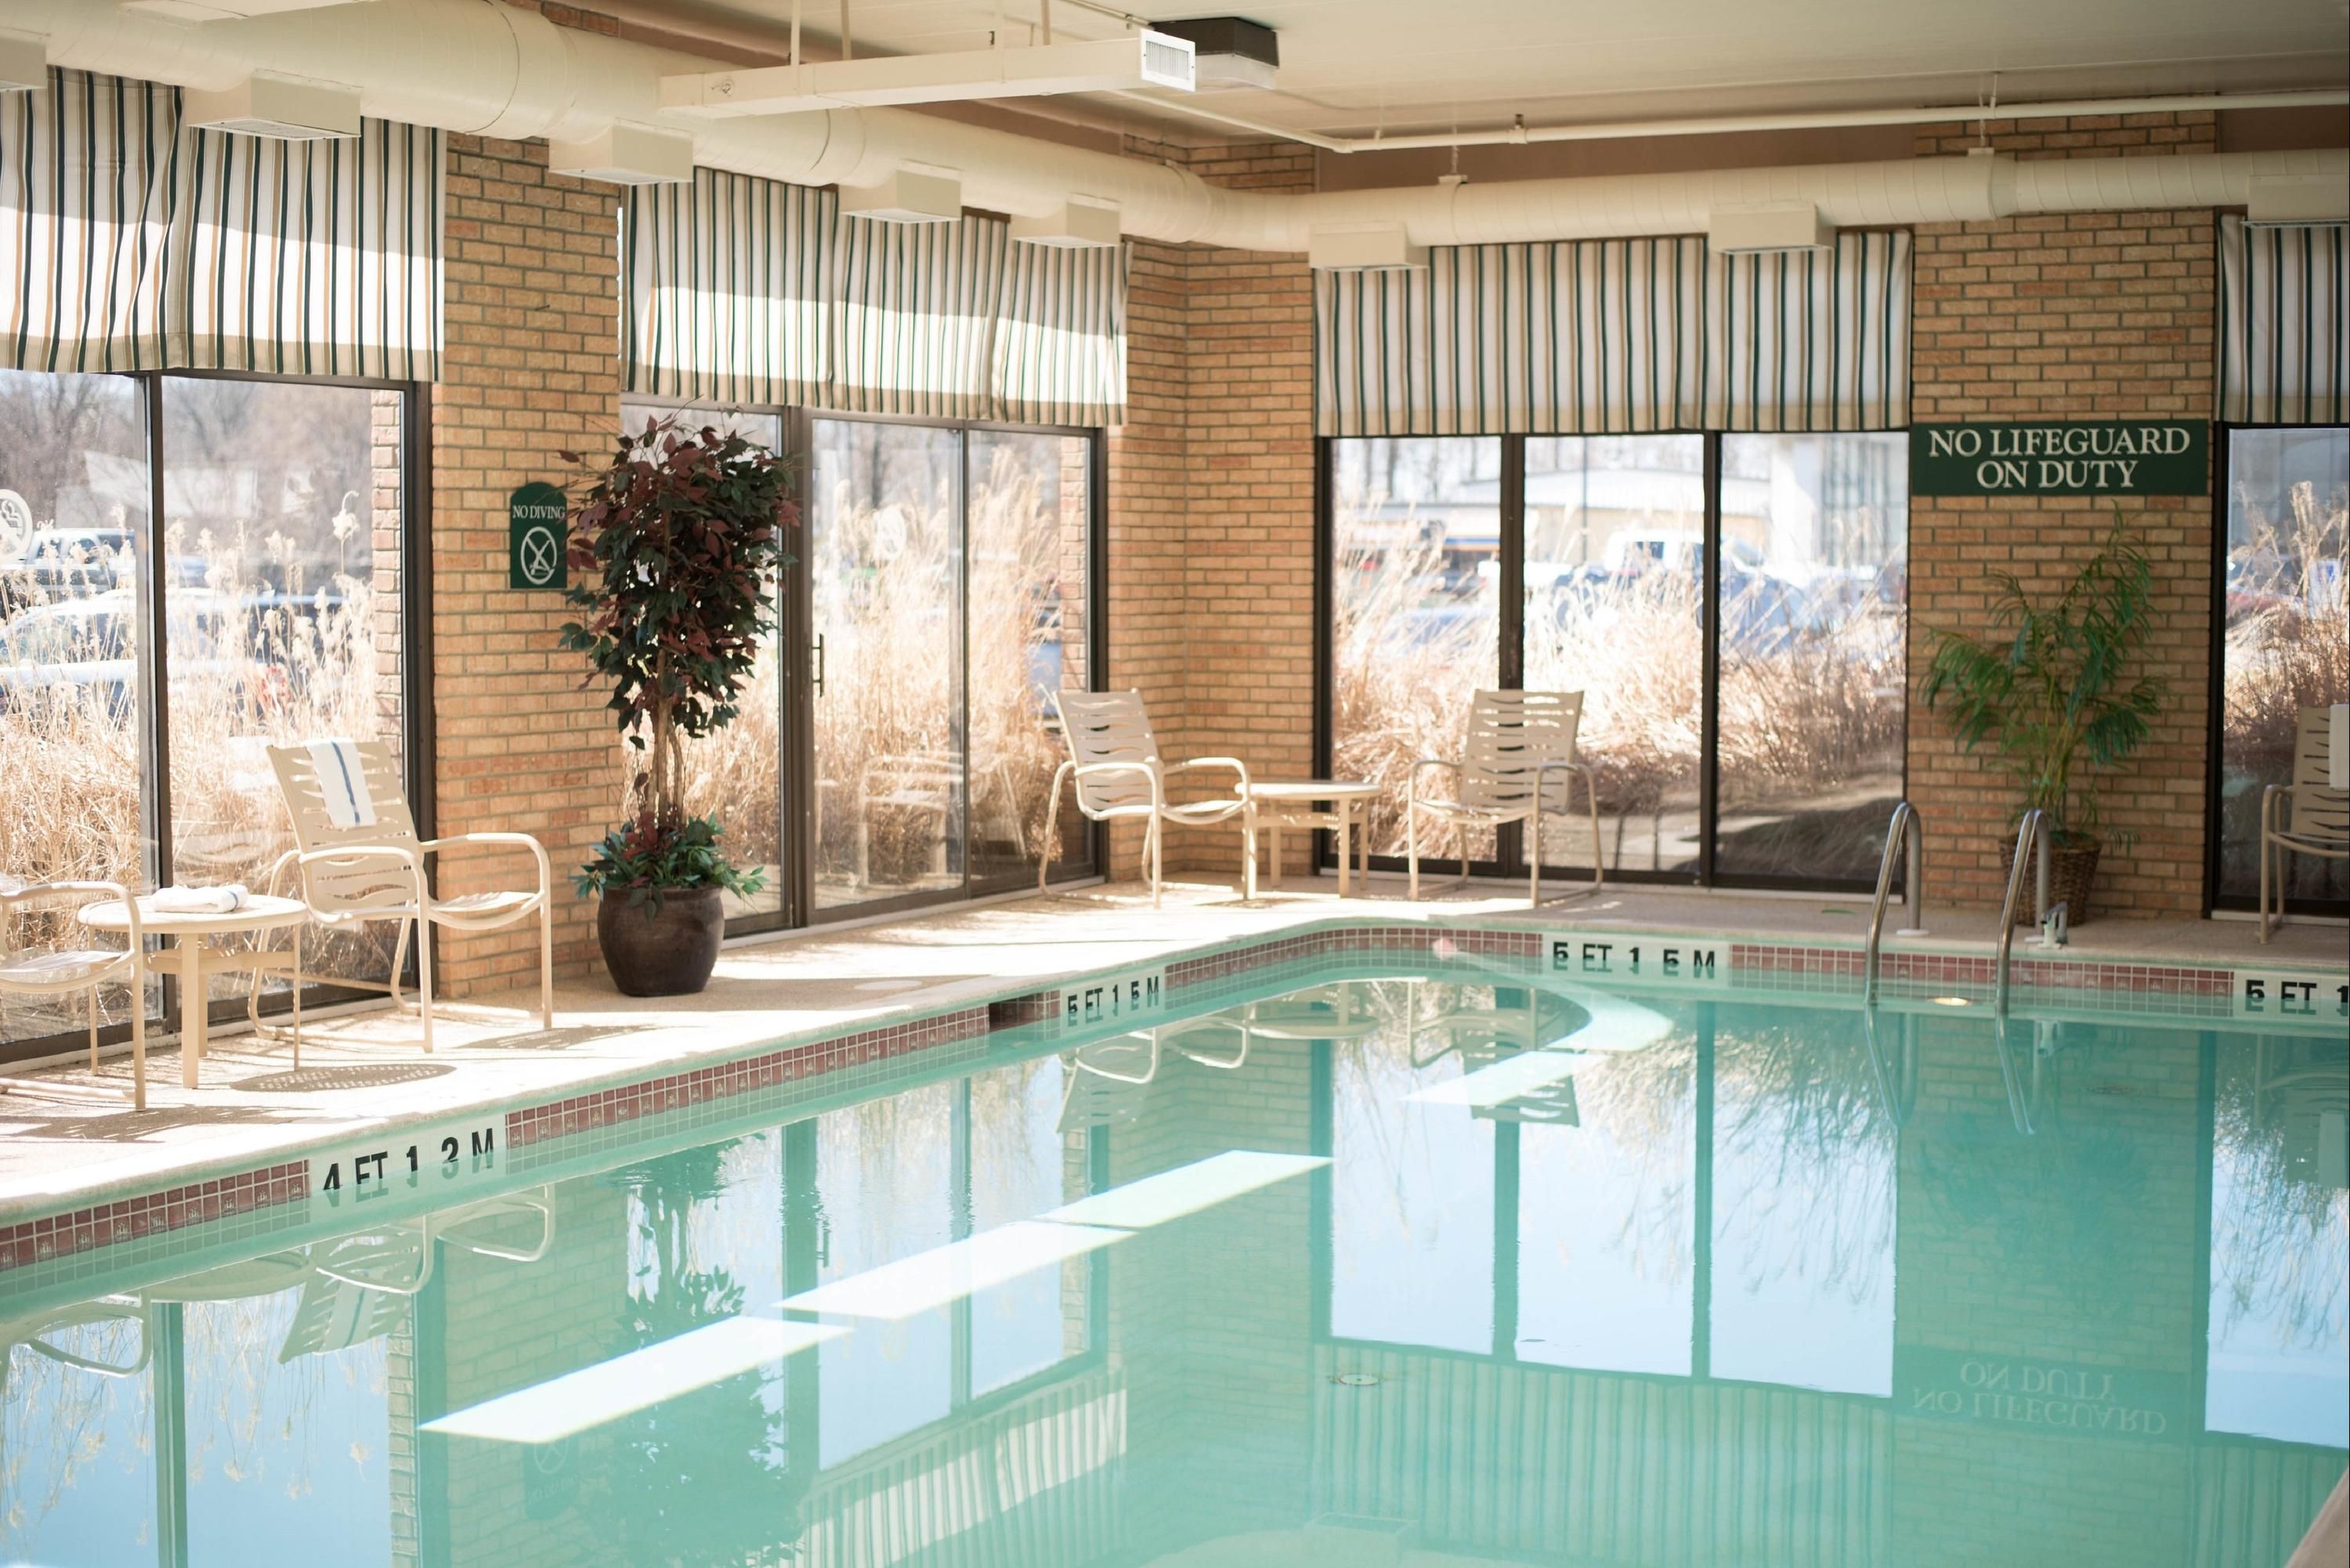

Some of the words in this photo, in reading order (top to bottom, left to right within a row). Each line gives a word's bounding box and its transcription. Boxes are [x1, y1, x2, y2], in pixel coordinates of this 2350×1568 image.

[1929, 429, 1982, 457] NO
[1990, 428, 2190, 456] LIFEGUARD
[1976, 461, 2028, 489] ON
[2038, 460, 2138, 489] DUTY
[512, 504, 529, 518] NO
[530, 505, 565, 519] DIVING
[1553, 941, 1569, 959] 5
[1582, 943, 1612, 961] FT
[1629, 947, 1639, 963] 1
[1663, 948, 1679, 965] 5
[1694, 949, 1715, 966] M
[1068, 995, 1078, 1013] 5
[1085, 988, 1103, 1009] FT
[1112, 984, 1118, 1003] 1
[1130, 981, 1140, 999] 5
[1147, 976, 1159, 995] M
[2247, 979, 2265, 999] 5
[2281, 981, 2317, 1001] FT
[323, 1163, 340, 1190] 4
[355, 1151, 388, 1184] FT
[407, 1145, 418, 1172] 1
[472, 1128, 494, 1156] M
